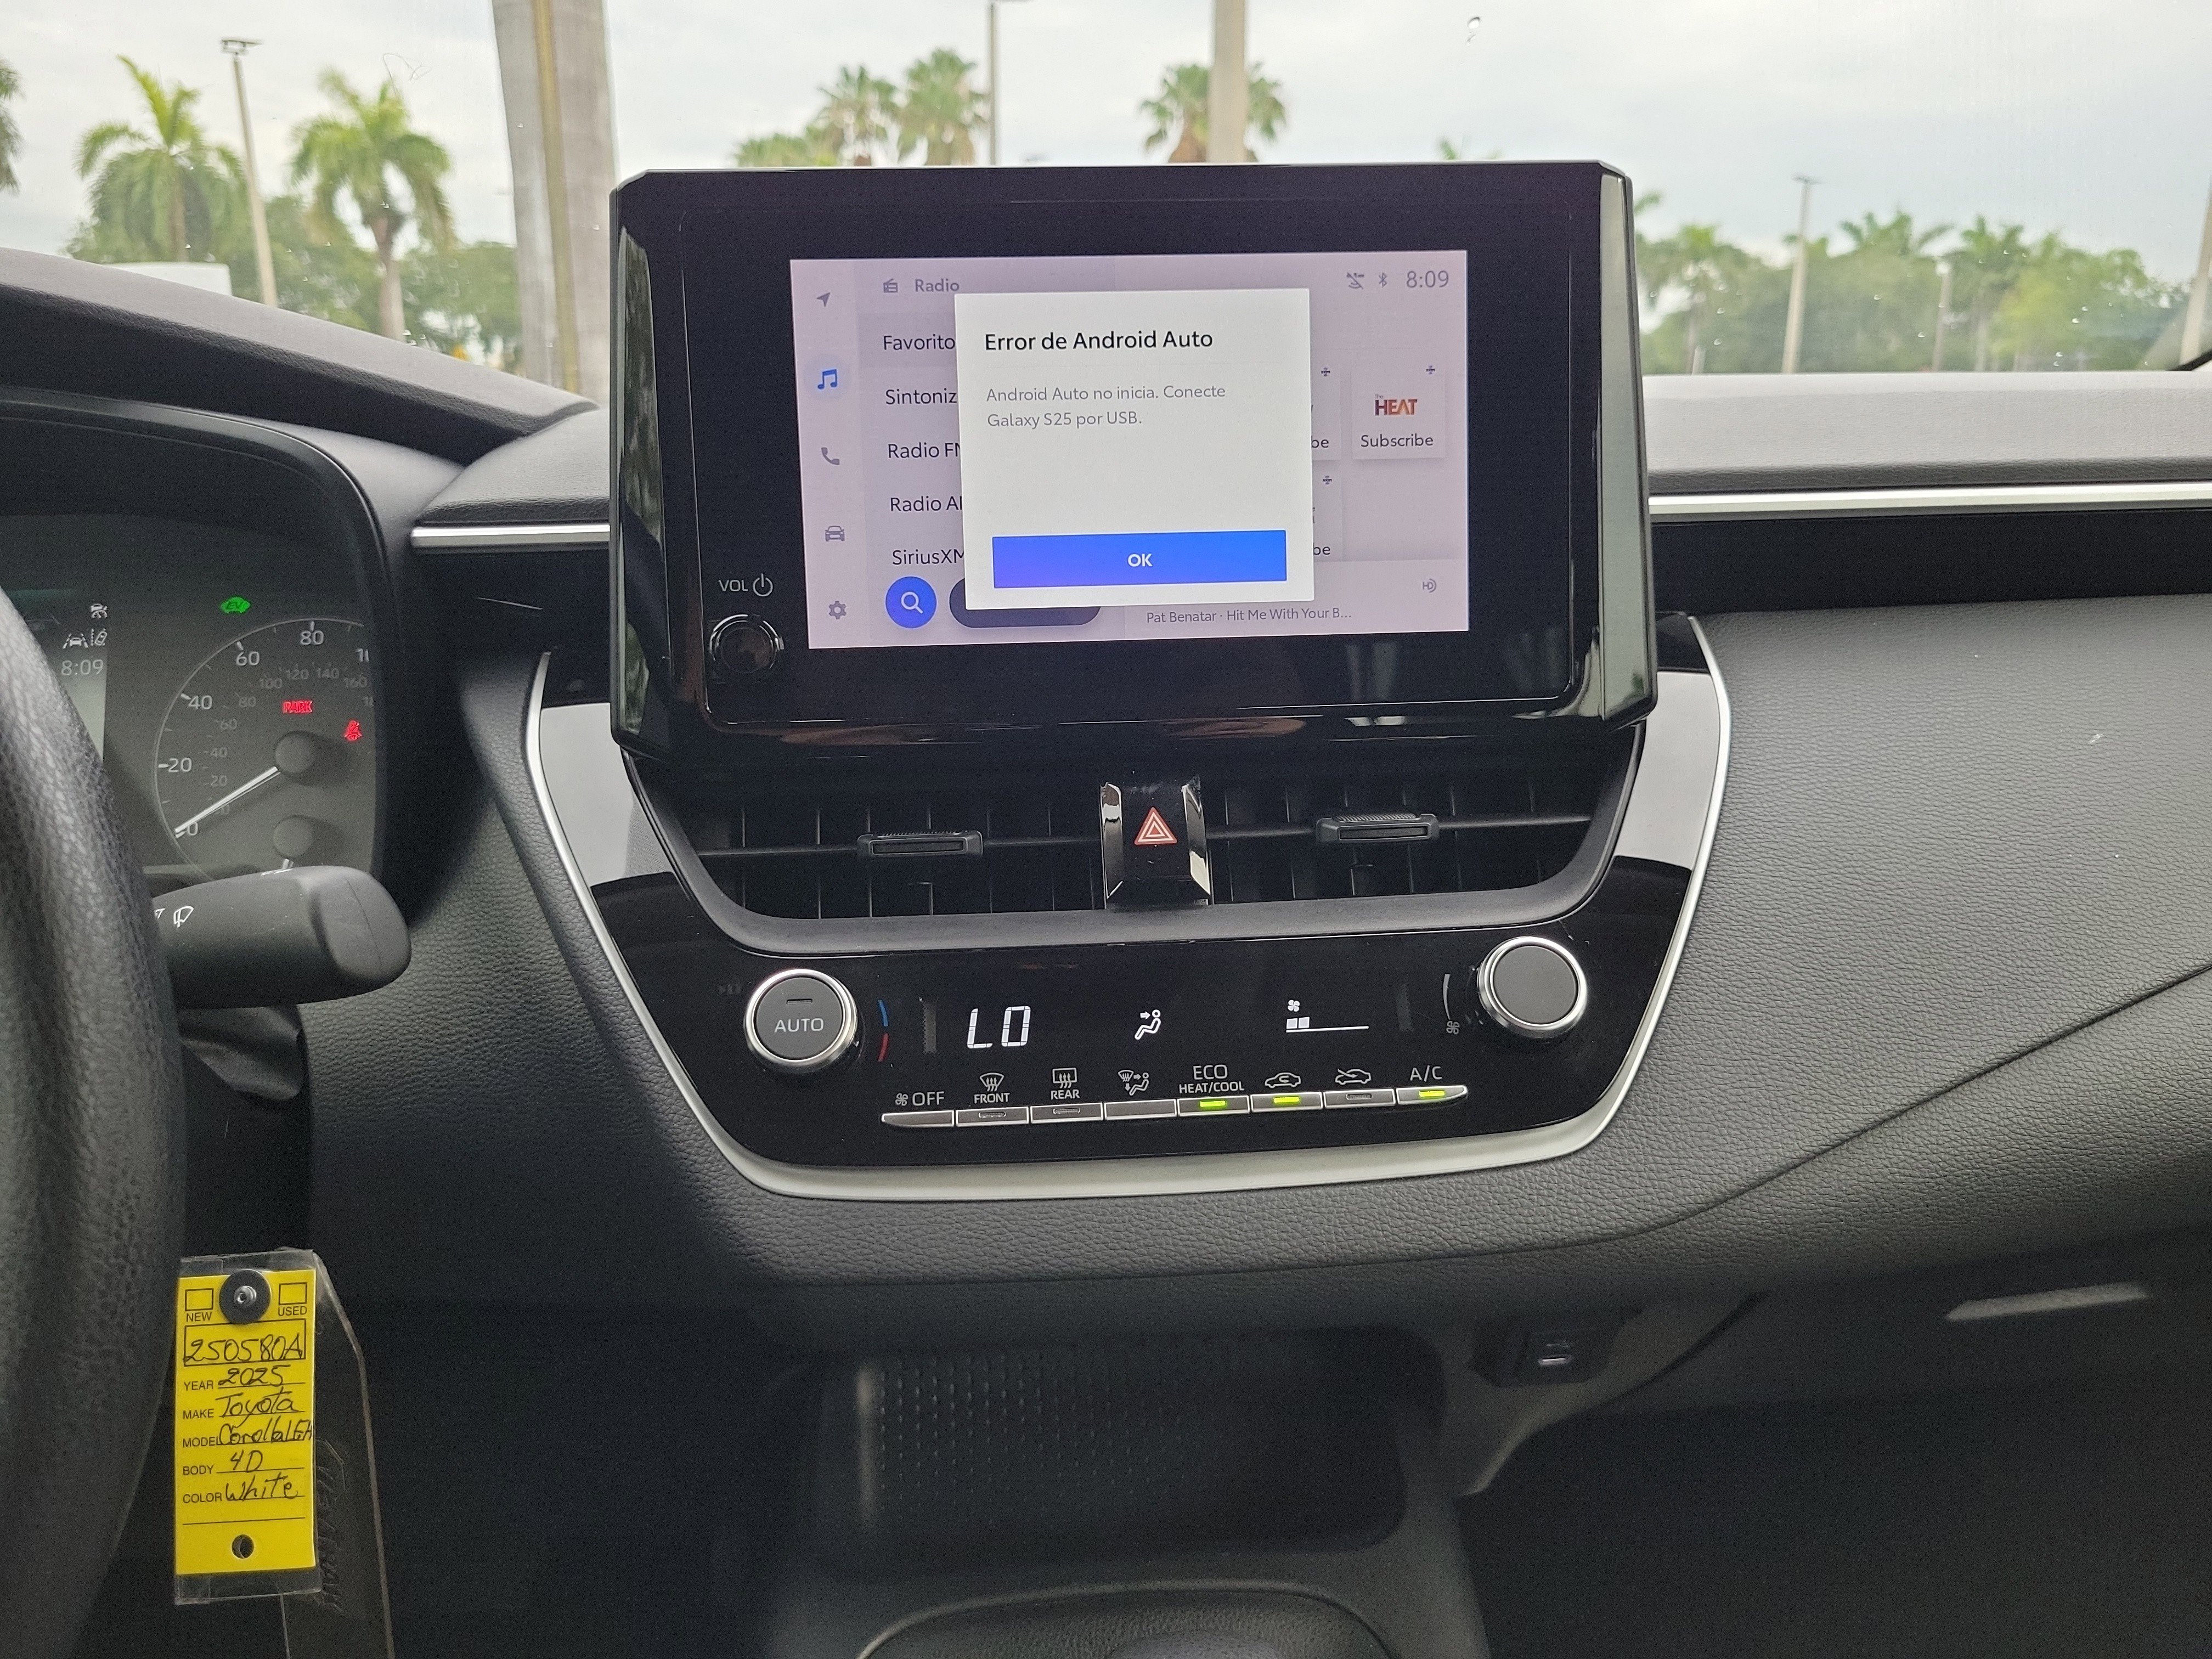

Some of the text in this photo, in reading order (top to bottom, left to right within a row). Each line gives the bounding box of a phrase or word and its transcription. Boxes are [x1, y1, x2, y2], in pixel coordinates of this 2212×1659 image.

[915, 278, 960, 292] Radio
[1406, 270, 1449, 288] 8:09
[884, 334, 955, 350] Favorito
[986, 331, 1212, 350] Error de Android Auto
[885, 388, 957, 405] Sintoniz
[986, 385, 1226, 402] Android Auto no inicia. Conecte
[1374, 399, 1418, 416] HEAT
[988, 411, 1142, 429] Galaxy S25 por USB.
[1361, 433, 1434, 447] Subscribe
[888, 442, 939, 459] Radio
[890, 495, 941, 512] Radio
[893, 549, 964, 565] SiriusXM
[1127, 553, 1153, 567] OK
[719, 579, 749, 592] VOL
[1147, 611, 1166, 623] Pat
[1170, 611, 1216, 623] Benatar
[1227, 609, 1244, 621] Hit
[1248, 609, 1267, 620] Me
[1269, 608, 1298, 620] With
[1301, 608, 1330, 619] Your
[300, 630, 324, 645] 80
[236, 651, 260, 666] 60
[61, 659, 104, 676] 8:09
[285, 669, 309, 680] 120
[316, 668, 340, 679] 140
[259, 678, 283, 689] 100
[343, 676, 368, 688] 160
[188, 695, 213, 710] 40
[239, 696, 256, 708] 80
[282, 700, 313, 714] PARK
[221, 719, 238, 730] 60
[210, 747, 228, 758] 40
[168, 758, 192, 772] 20
[211, 775, 228, 787] 20
[187, 822, 198, 836] 0
[774, 1018, 825, 1033] AUTO
[967, 1006, 1031, 1049] LO
[1193, 1064, 1228, 1080] ECO
[1410, 1065, 1442, 1082] A/C
[1051, 1089, 1080, 1100] REAR
[1179, 1081, 1245, 1094] HEAT/COOL
[912, 1091, 945, 1107] OFF
[974, 1092, 1011, 1103] FRONT
[186, 1312, 212, 1322] NEW
[278, 1306, 307, 1317] USED
[218, 1364, 290, 1387] 2025
[183, 1381, 214, 1391] YEAR
[215, 1386, 301, 1427] Toyota
[183, 1409, 214, 1419] MAKE
[182, 1435, 221, 1447] MODEL
[230, 1449, 263, 1473] 4D
[183, 1465, 214, 1475] BODY
[225, 1472, 299, 1501] White
[183, 1492, 222, 1504] COLOR
